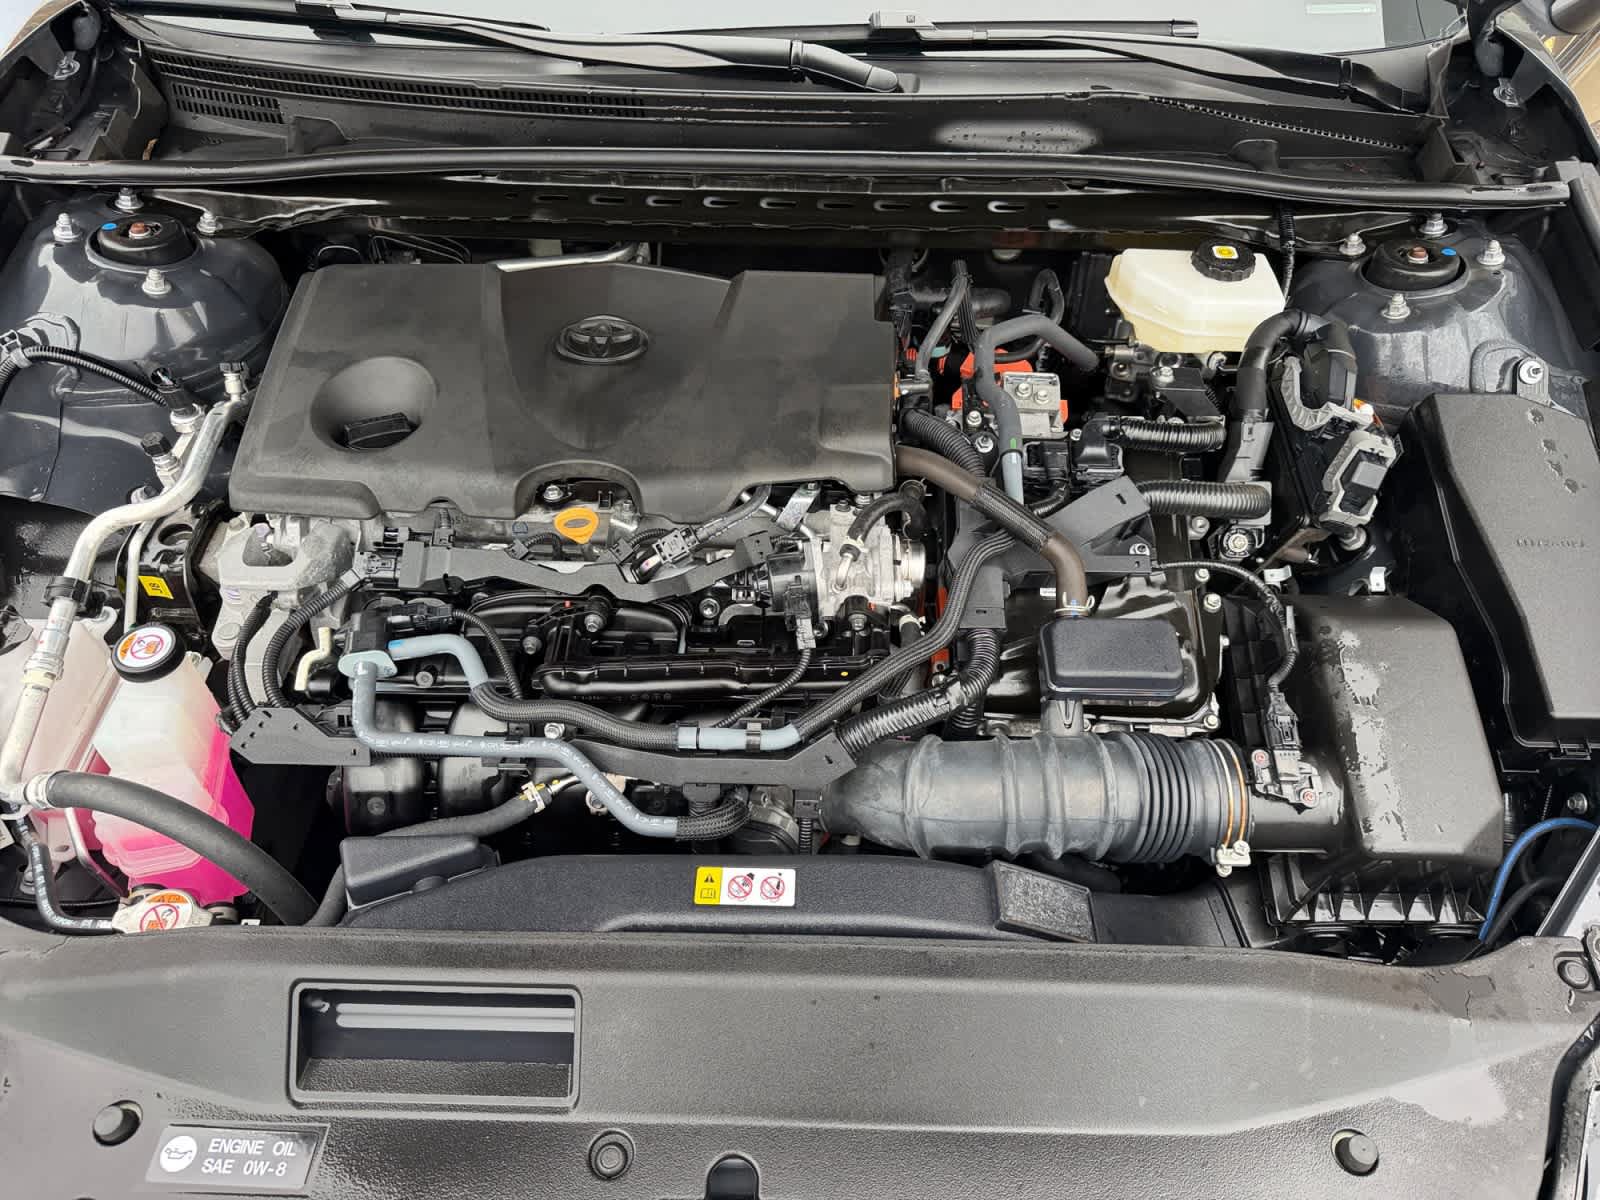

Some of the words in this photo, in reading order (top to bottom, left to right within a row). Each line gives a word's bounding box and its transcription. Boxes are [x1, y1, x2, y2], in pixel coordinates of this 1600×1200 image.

[207, 1138, 265, 1155] ENGINE
[272, 1141, 297, 1157] OIL
[201, 1158, 235, 1174] SAE
[243, 1160, 287, 1177] 0W-8
